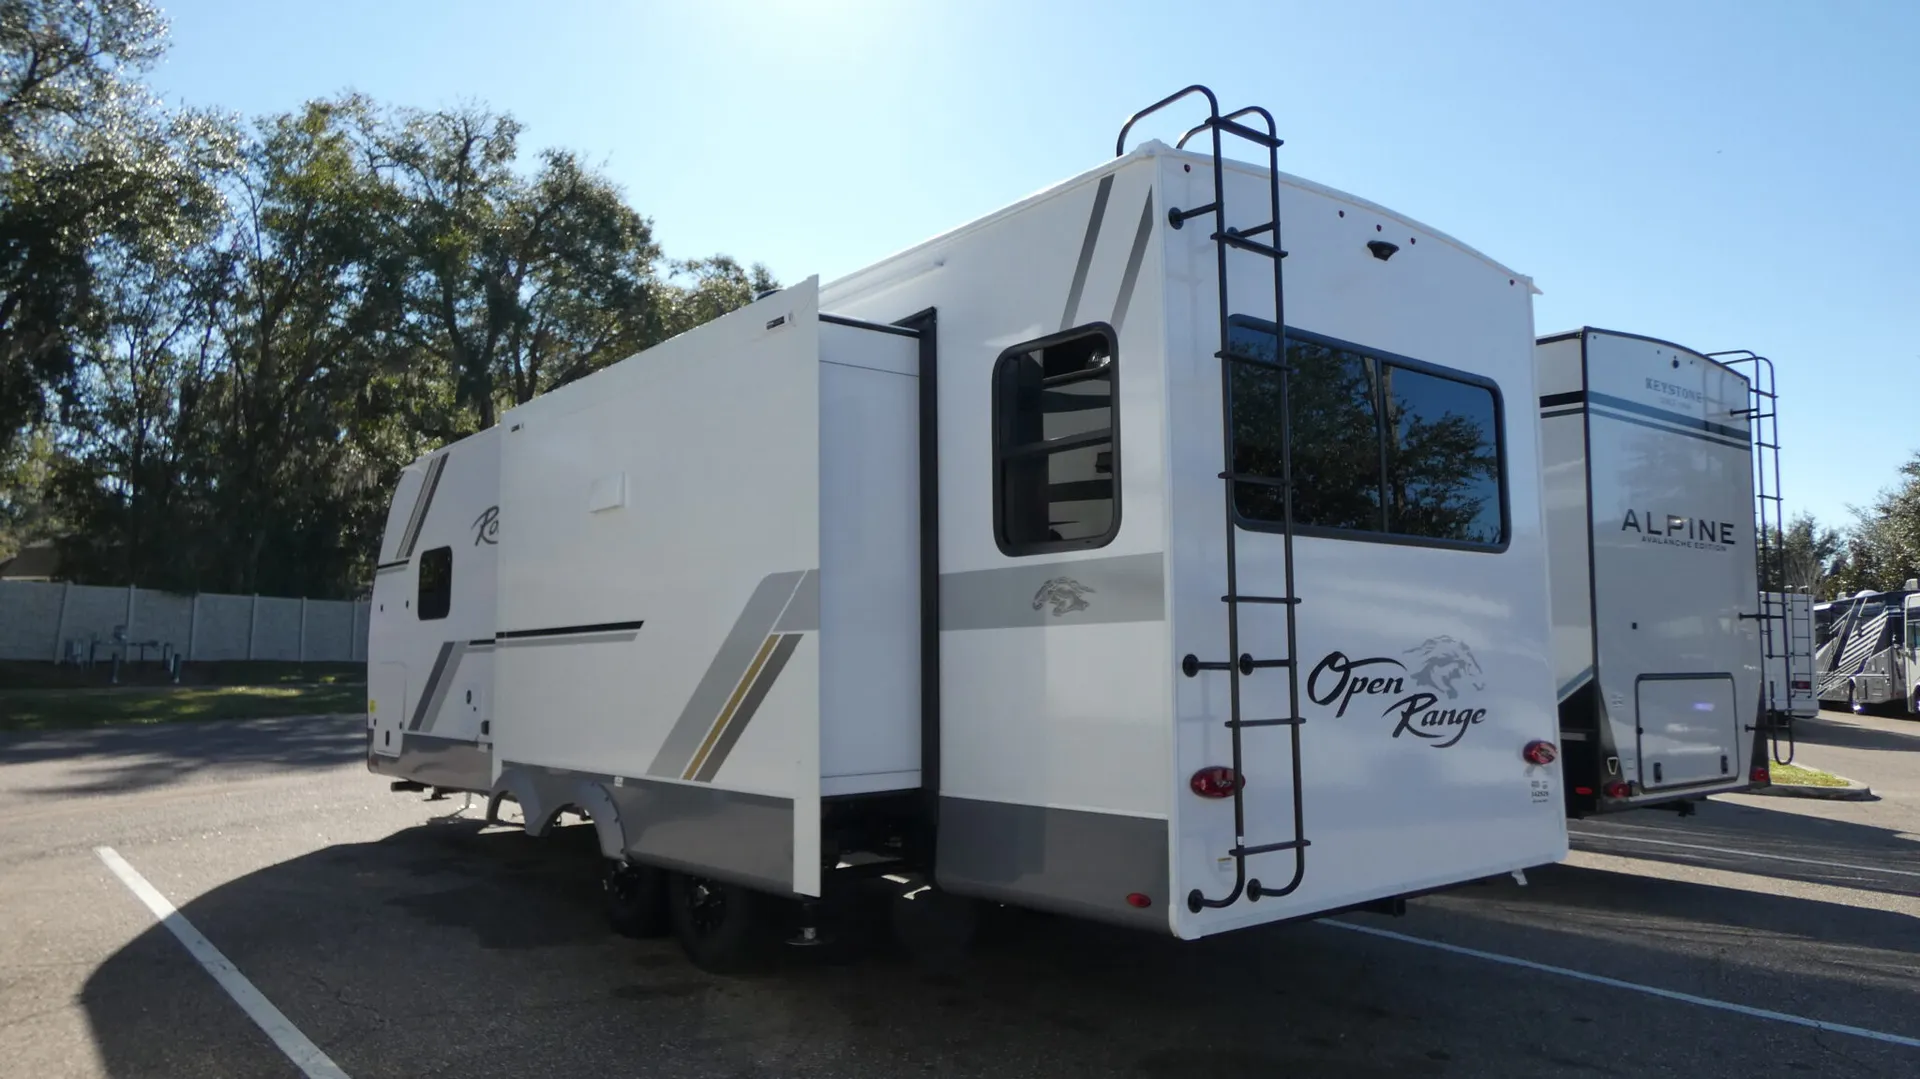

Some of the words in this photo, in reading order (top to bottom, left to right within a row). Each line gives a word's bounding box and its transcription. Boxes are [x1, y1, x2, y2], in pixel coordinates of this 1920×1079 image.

[1645, 377, 1702, 403] KEYSTONE
[1621, 508, 1736, 545] ALPINE
[1641, 535, 1692, 548] AVALANCHE
[1307, 651, 1408, 718] Open
[1381, 692, 1487, 748] Range
